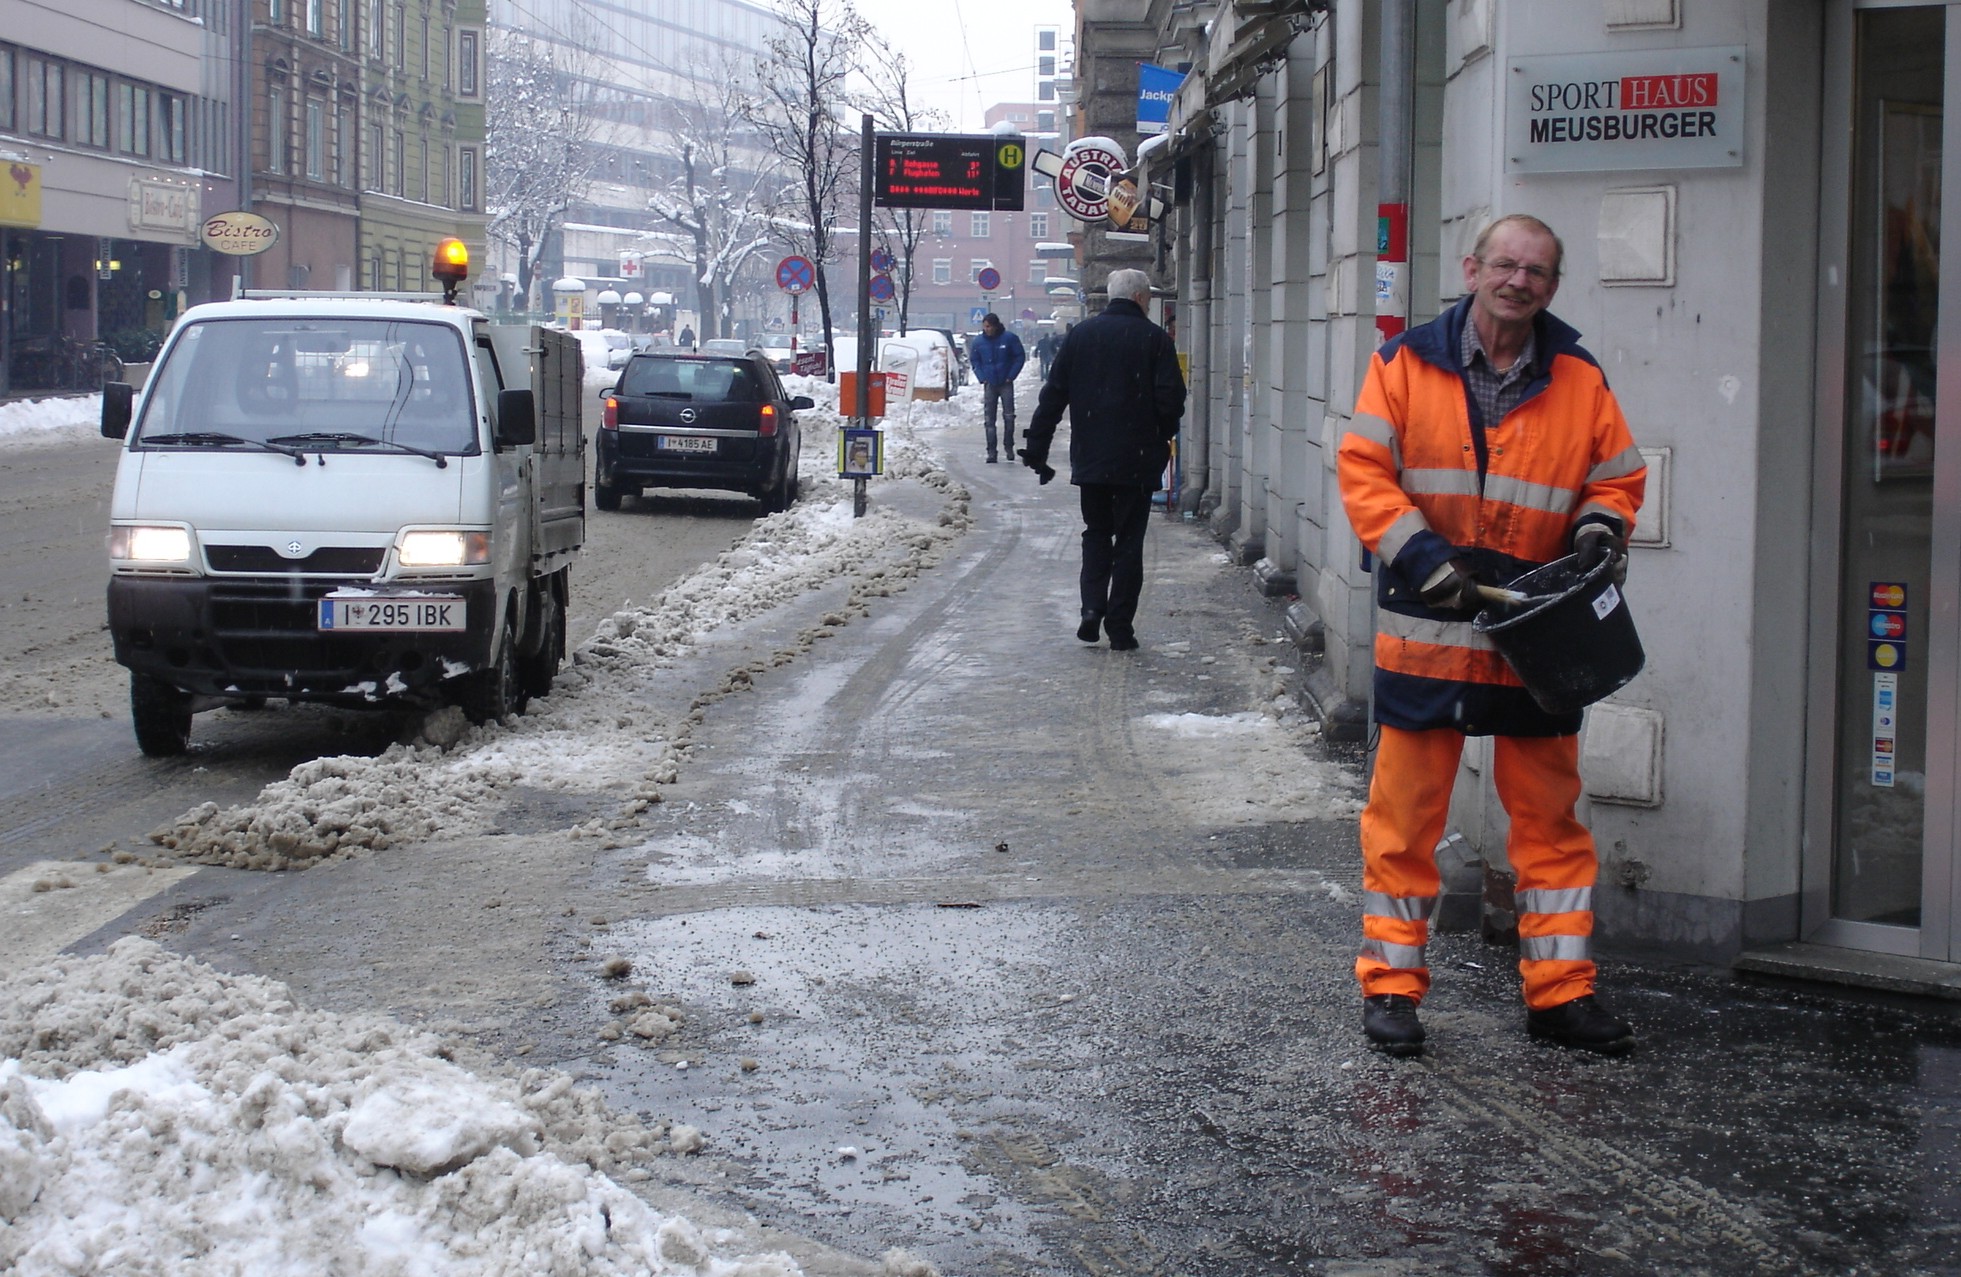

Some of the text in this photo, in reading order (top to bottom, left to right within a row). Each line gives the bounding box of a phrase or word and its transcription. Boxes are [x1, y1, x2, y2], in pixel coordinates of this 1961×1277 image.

[1140, 89, 1174, 103] Jackp
[1531, 77, 1707, 111] SPORT HAUS
[1530, 111, 1716, 143] MEUSBURGER
[890, 140, 934, 148] Bürgerstraße
[1004, 148, 1017, 164] H
[206, 220, 272, 238] Bistro
[677, 438, 700, 449] 4185
[701, 440, 713, 449] AE
[368, 604, 409, 626] 295
[417, 604, 451, 626] IBK
